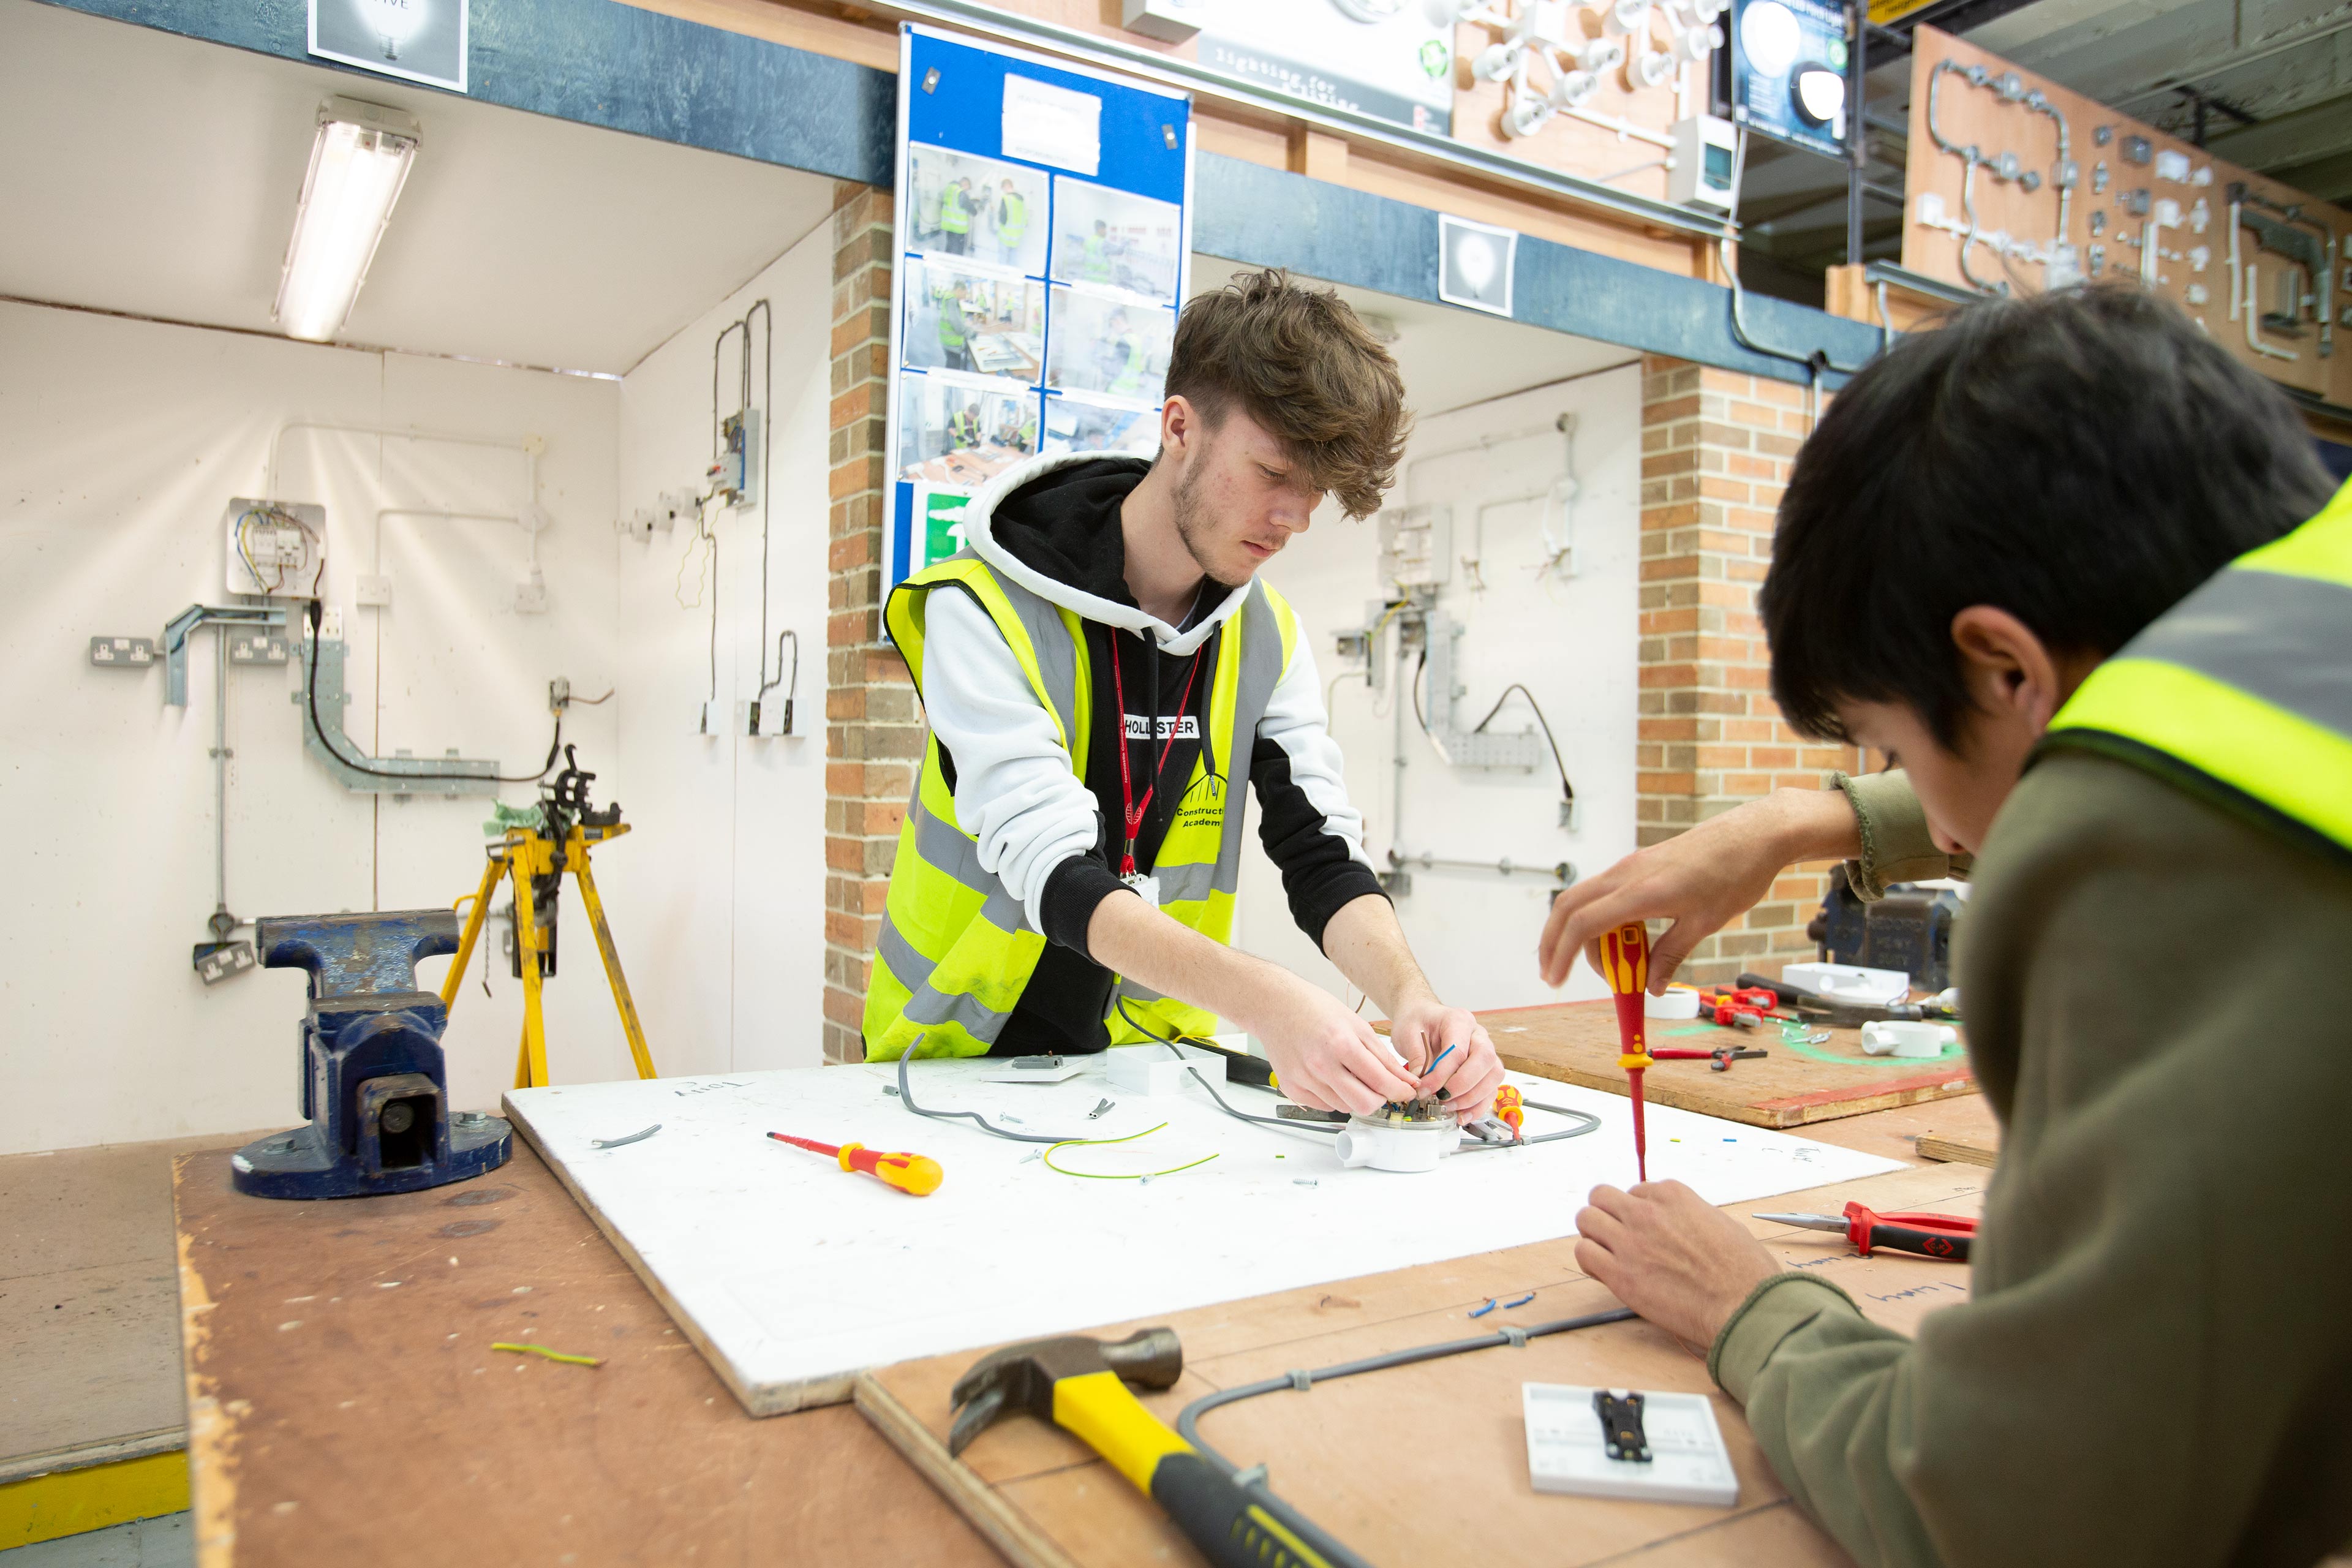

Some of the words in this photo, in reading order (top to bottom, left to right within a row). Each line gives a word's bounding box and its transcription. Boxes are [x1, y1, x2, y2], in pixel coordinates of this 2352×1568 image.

[1215, 47, 1302, 89] lighting
[1308, 75, 1336, 94] for
[1125, 720, 1194, 734] HOLLSTER
[1938, 1213, 1969, 1223] RedLine
[1786, 1256, 1841, 1268] way
[1865, 1286, 1940, 1302] way
